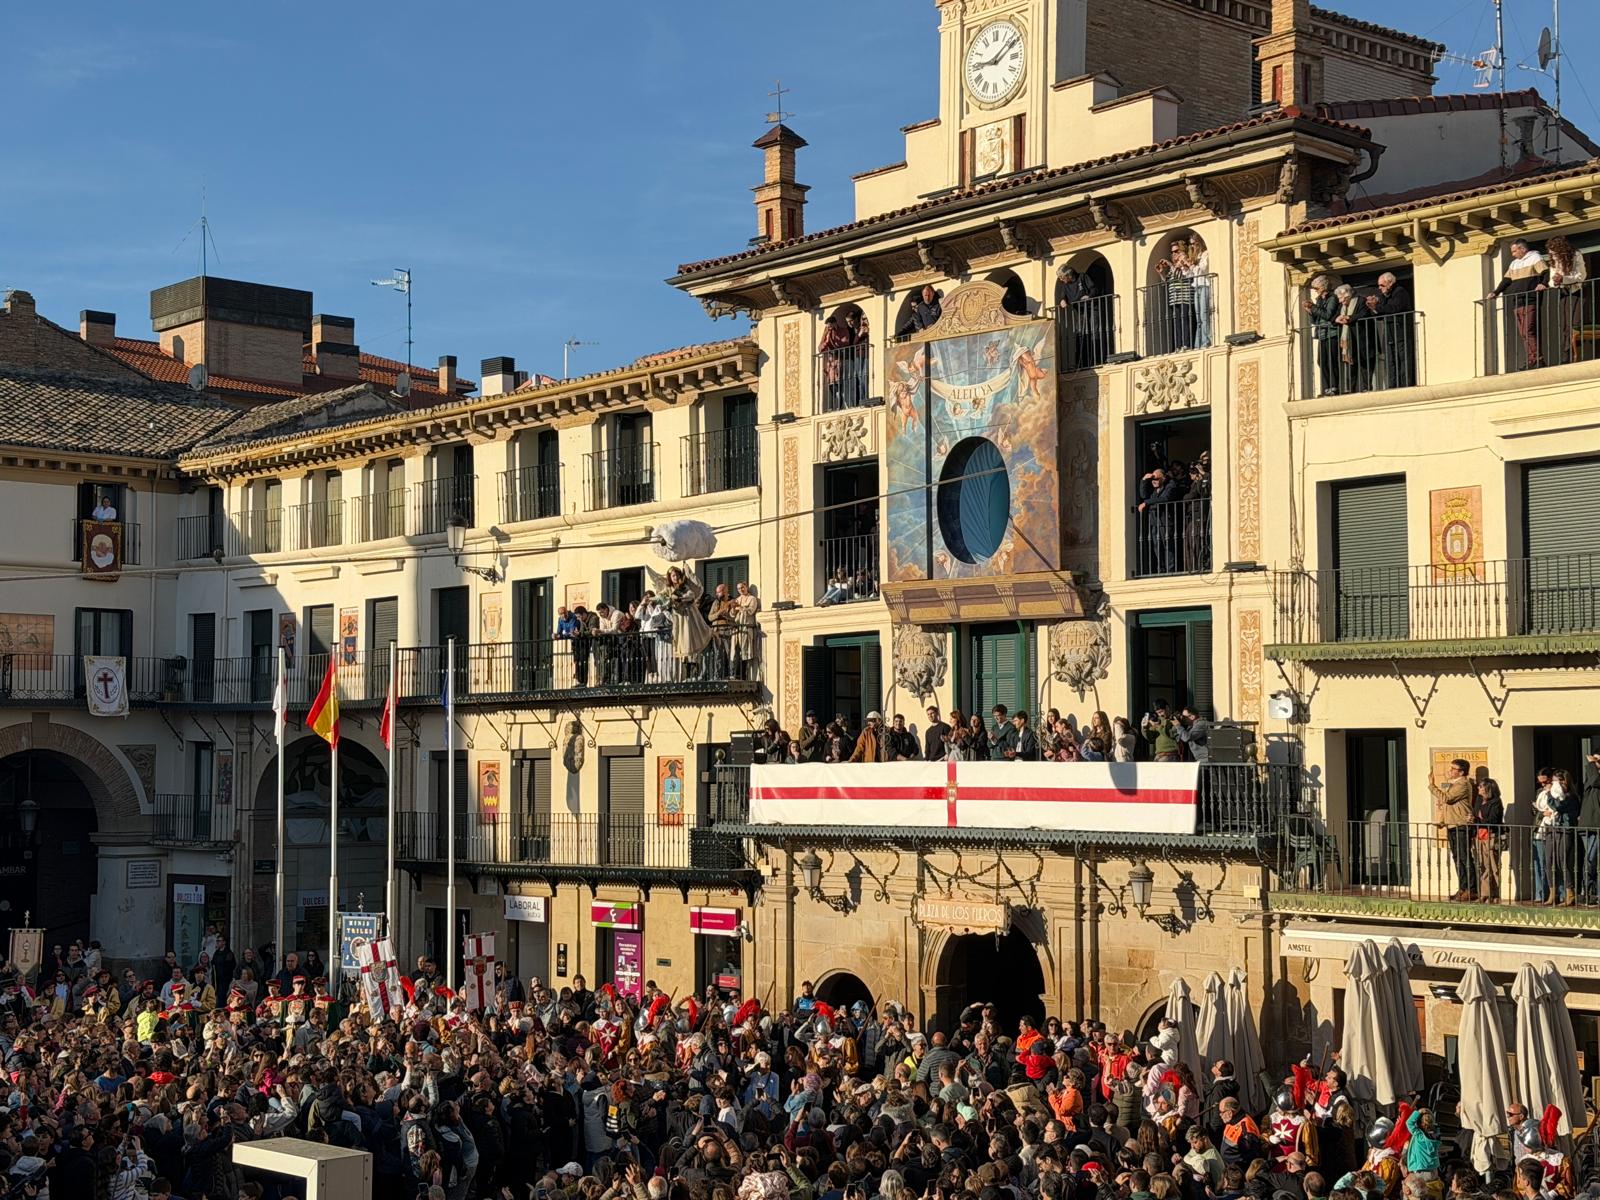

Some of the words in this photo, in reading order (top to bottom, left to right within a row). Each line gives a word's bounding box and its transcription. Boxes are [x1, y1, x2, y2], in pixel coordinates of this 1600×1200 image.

[950, 383, 994, 400] ALELUYA
[509, 899, 541, 911] LABORAL
[919, 903, 940, 919] PLAZA
[941, 904, 951, 920] DE
[952, 906, 969, 921] LOS
[972, 907, 1002, 923] FUEROS
[1287, 943, 1313, 953] AMSTEL
[1432, 950, 1477, 965] Plaza
[1566, 963, 1599, 973] AMSTEL
